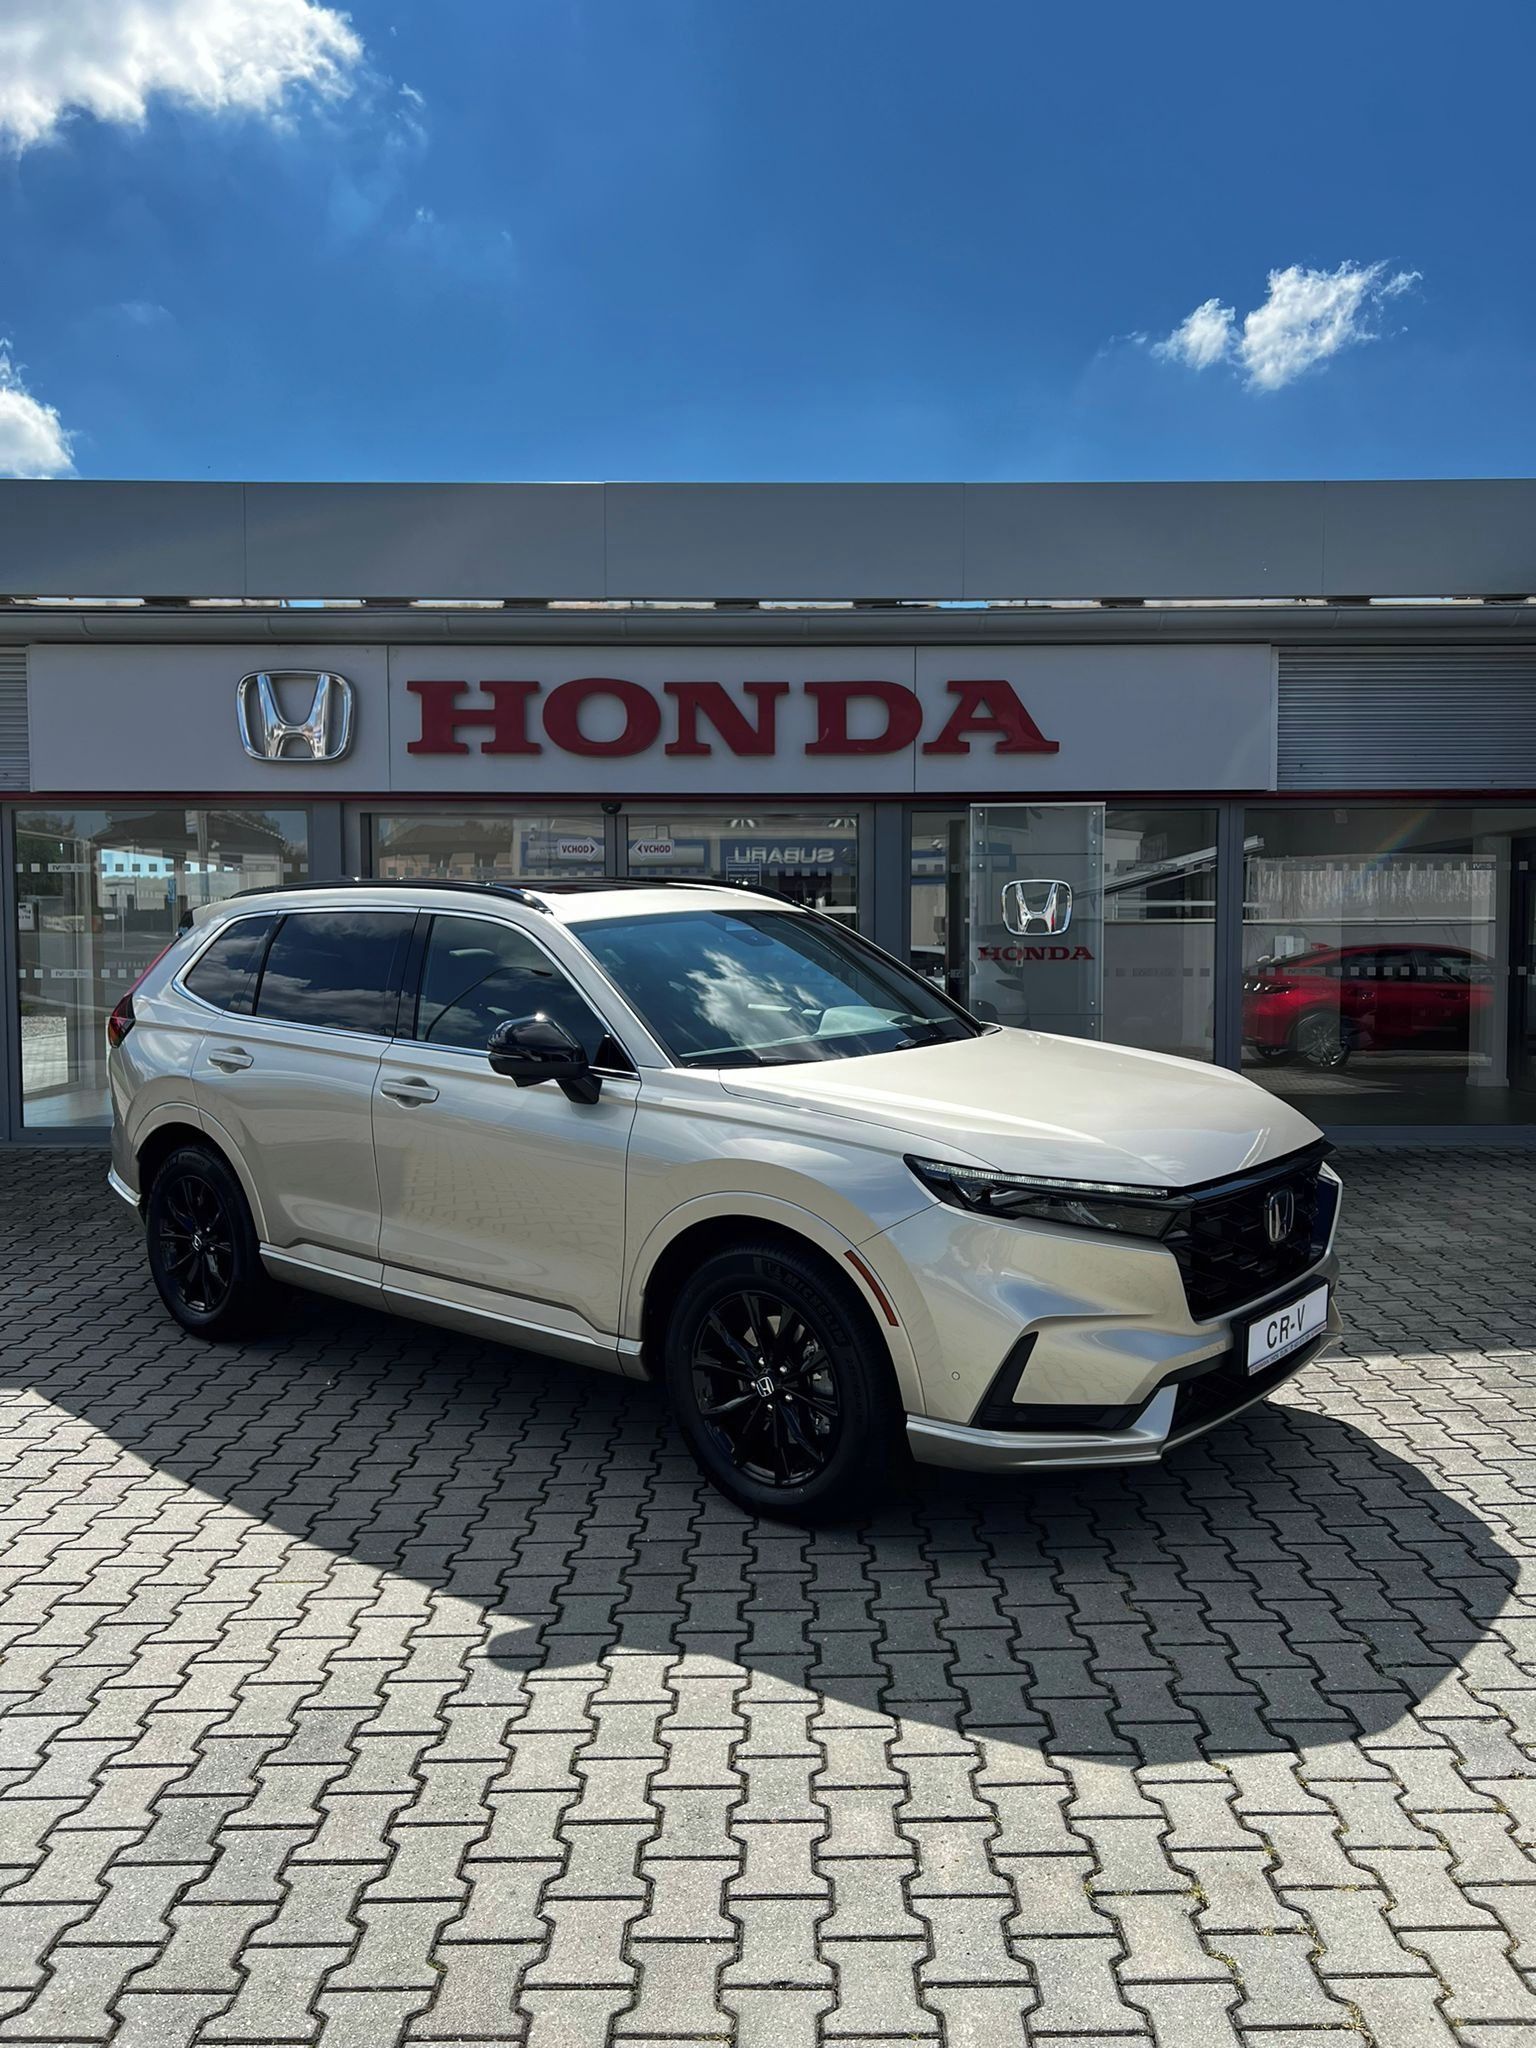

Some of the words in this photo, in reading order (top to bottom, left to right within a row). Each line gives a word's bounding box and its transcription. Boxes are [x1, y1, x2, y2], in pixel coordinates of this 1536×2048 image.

[408, 678, 1059, 755] HONDA
[561, 844, 590, 854] VCHOD
[643, 844, 671, 854] VCHOD
[977, 946, 1095, 960] HONDA
[1266, 1303, 1306, 1349] CR-V
